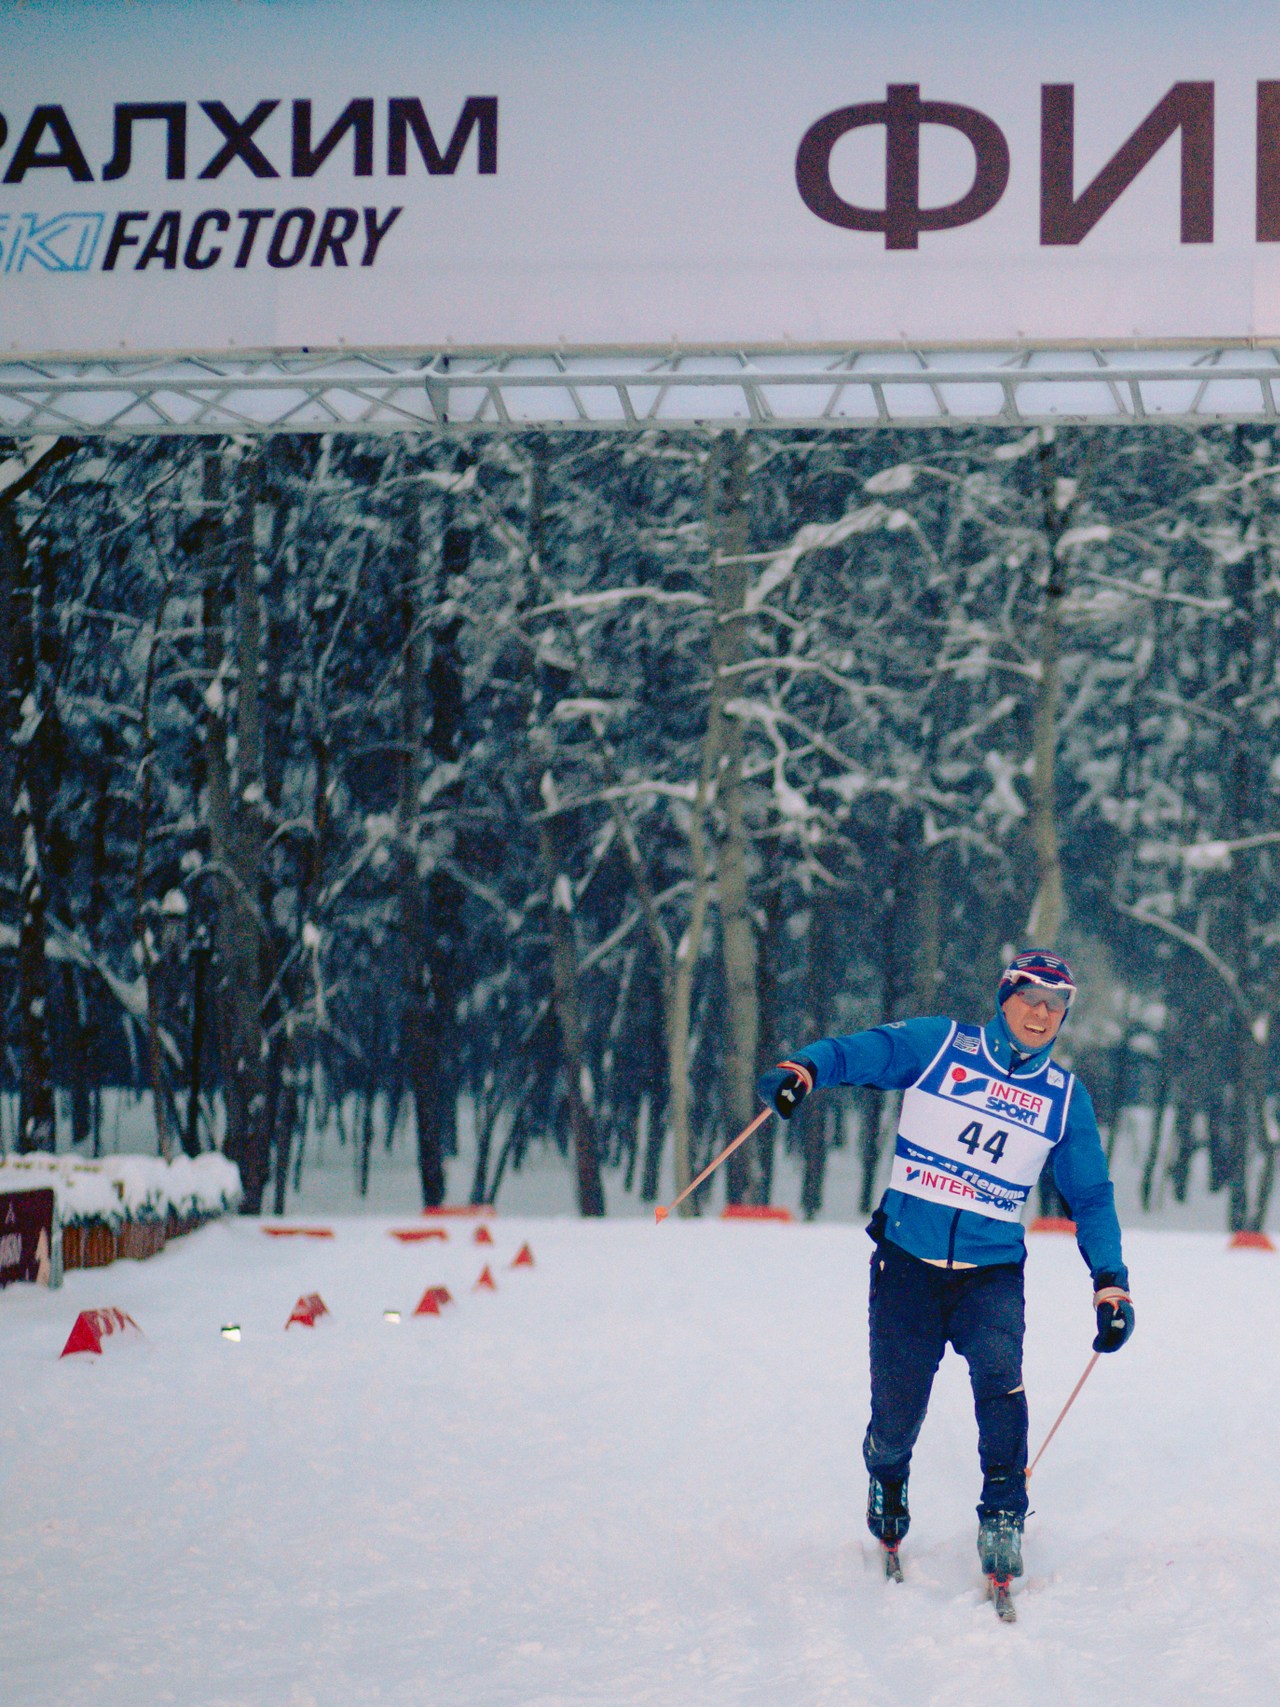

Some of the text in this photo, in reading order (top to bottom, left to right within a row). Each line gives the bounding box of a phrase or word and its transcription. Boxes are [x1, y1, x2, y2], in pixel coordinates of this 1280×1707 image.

[0, 96, 498, 184] АЛХИМ
[0, 206, 404, 273] KI FACTORY
[985, 1096, 1039, 1126] SPORT
[990, 1081, 1044, 1113] INTER
[957, 1120, 1009, 1165] 44
